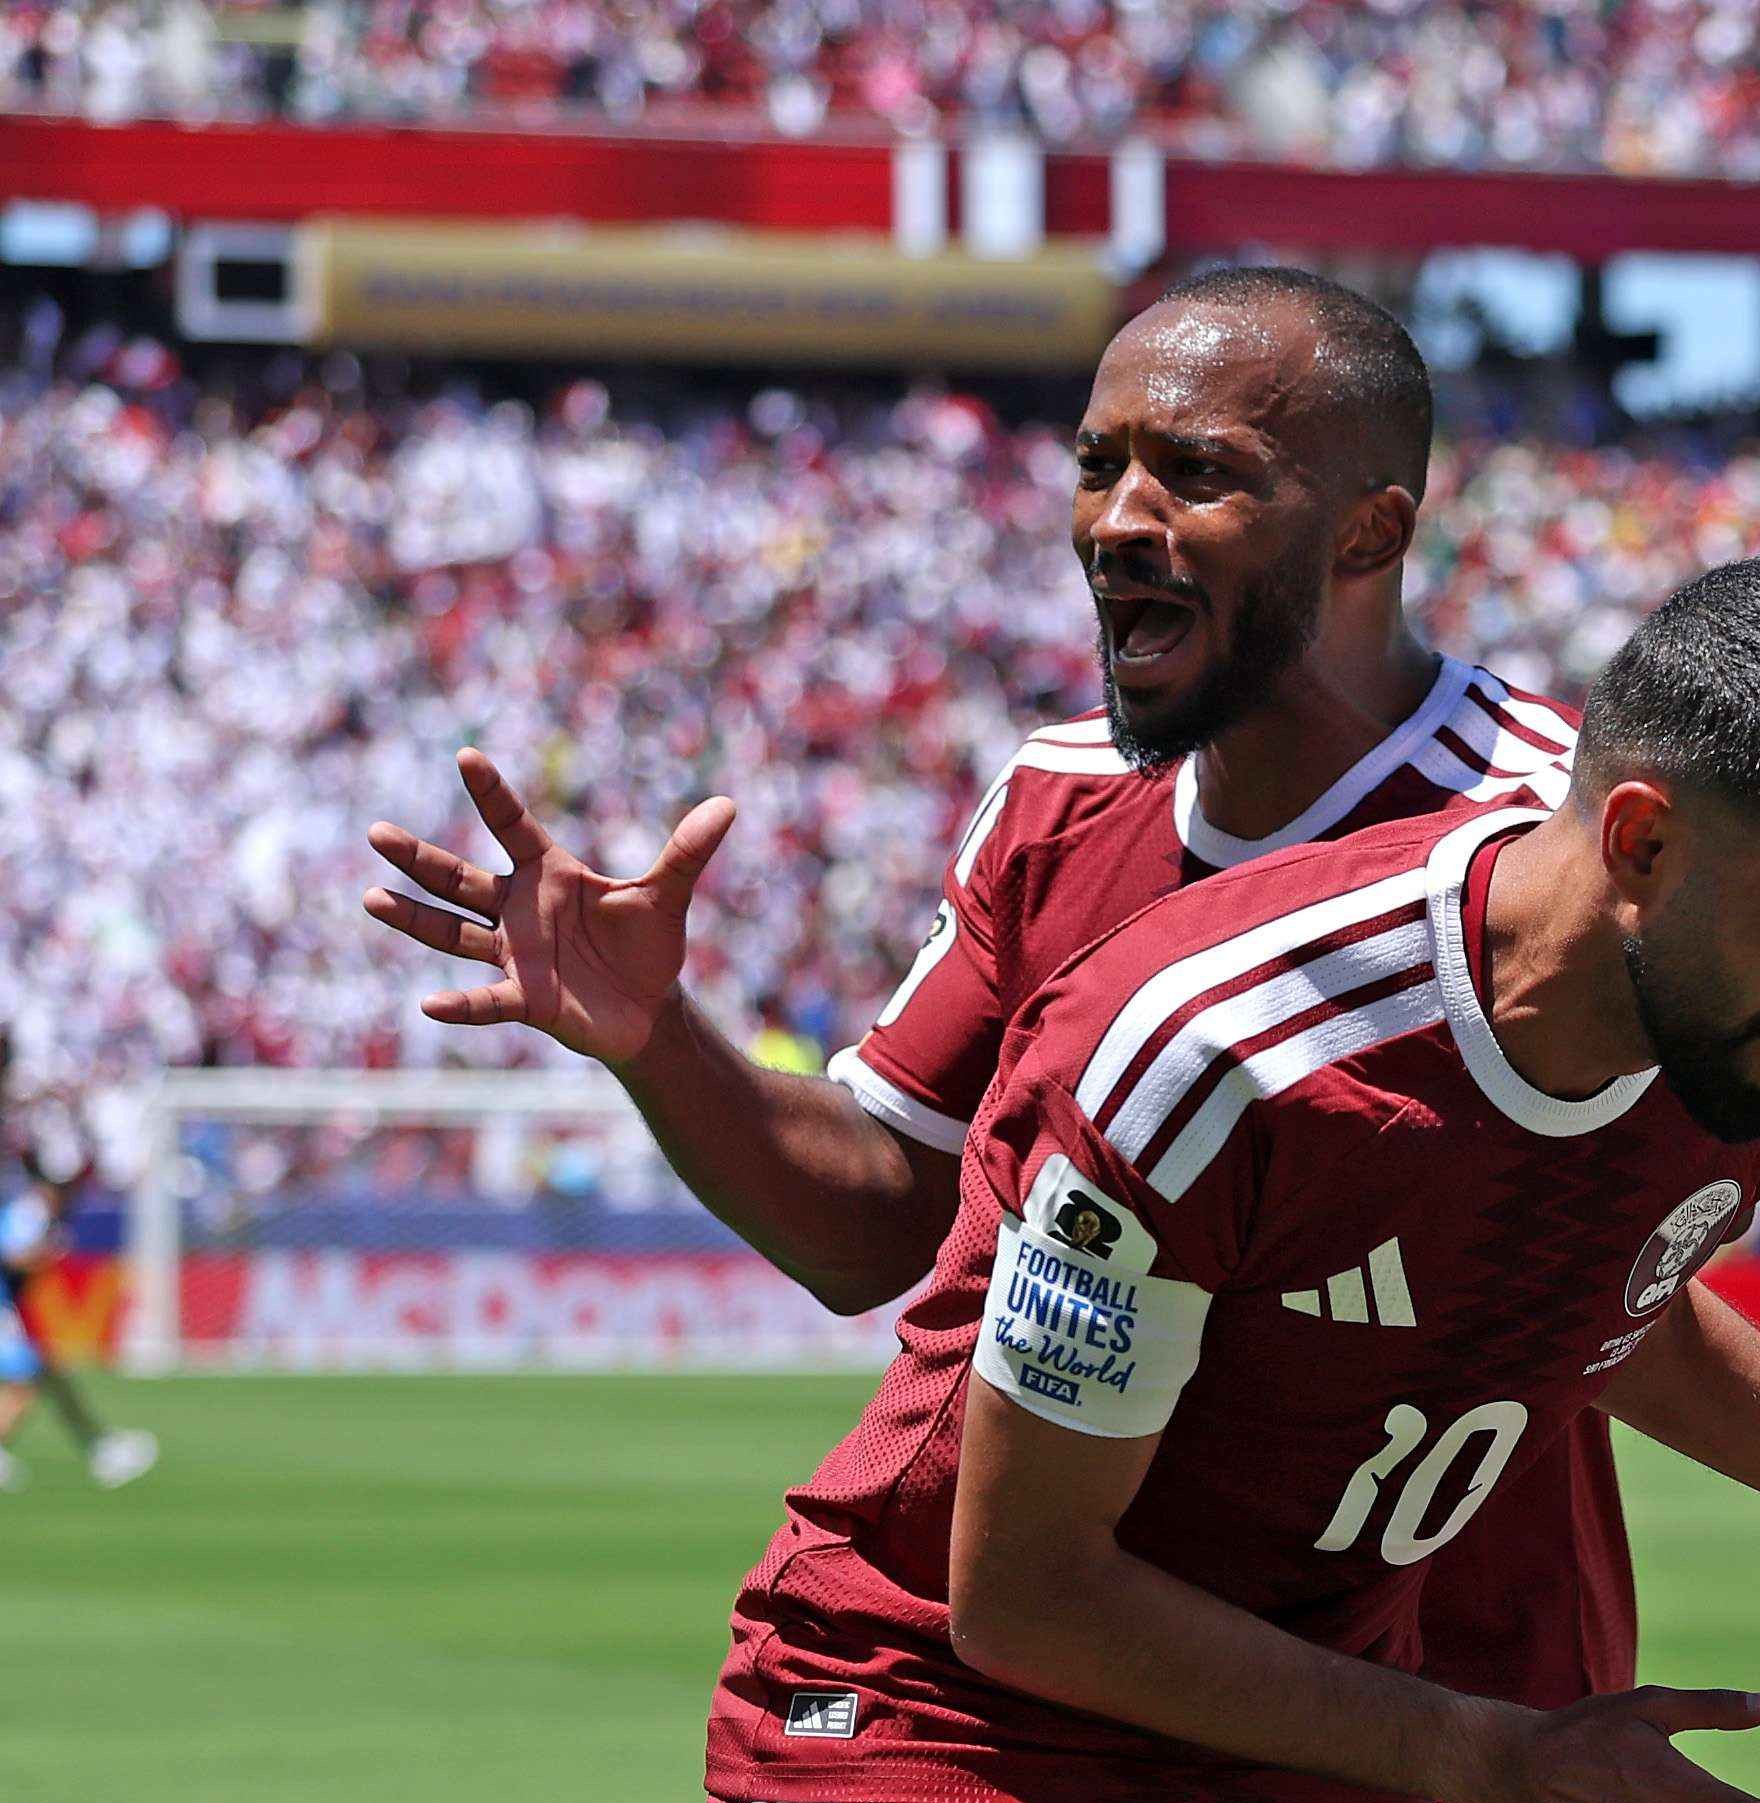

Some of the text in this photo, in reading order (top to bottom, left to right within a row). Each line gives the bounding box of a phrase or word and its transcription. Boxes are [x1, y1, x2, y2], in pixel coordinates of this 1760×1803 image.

[1007, 1272, 1135, 1352] UNITES
[1016, 1241, 1138, 1313] FOOTBALL
[994, 1316, 1136, 1394] the World
[1023, 1370, 1074, 1399] FIFA
[1314, 1401, 1528, 1565] 10
